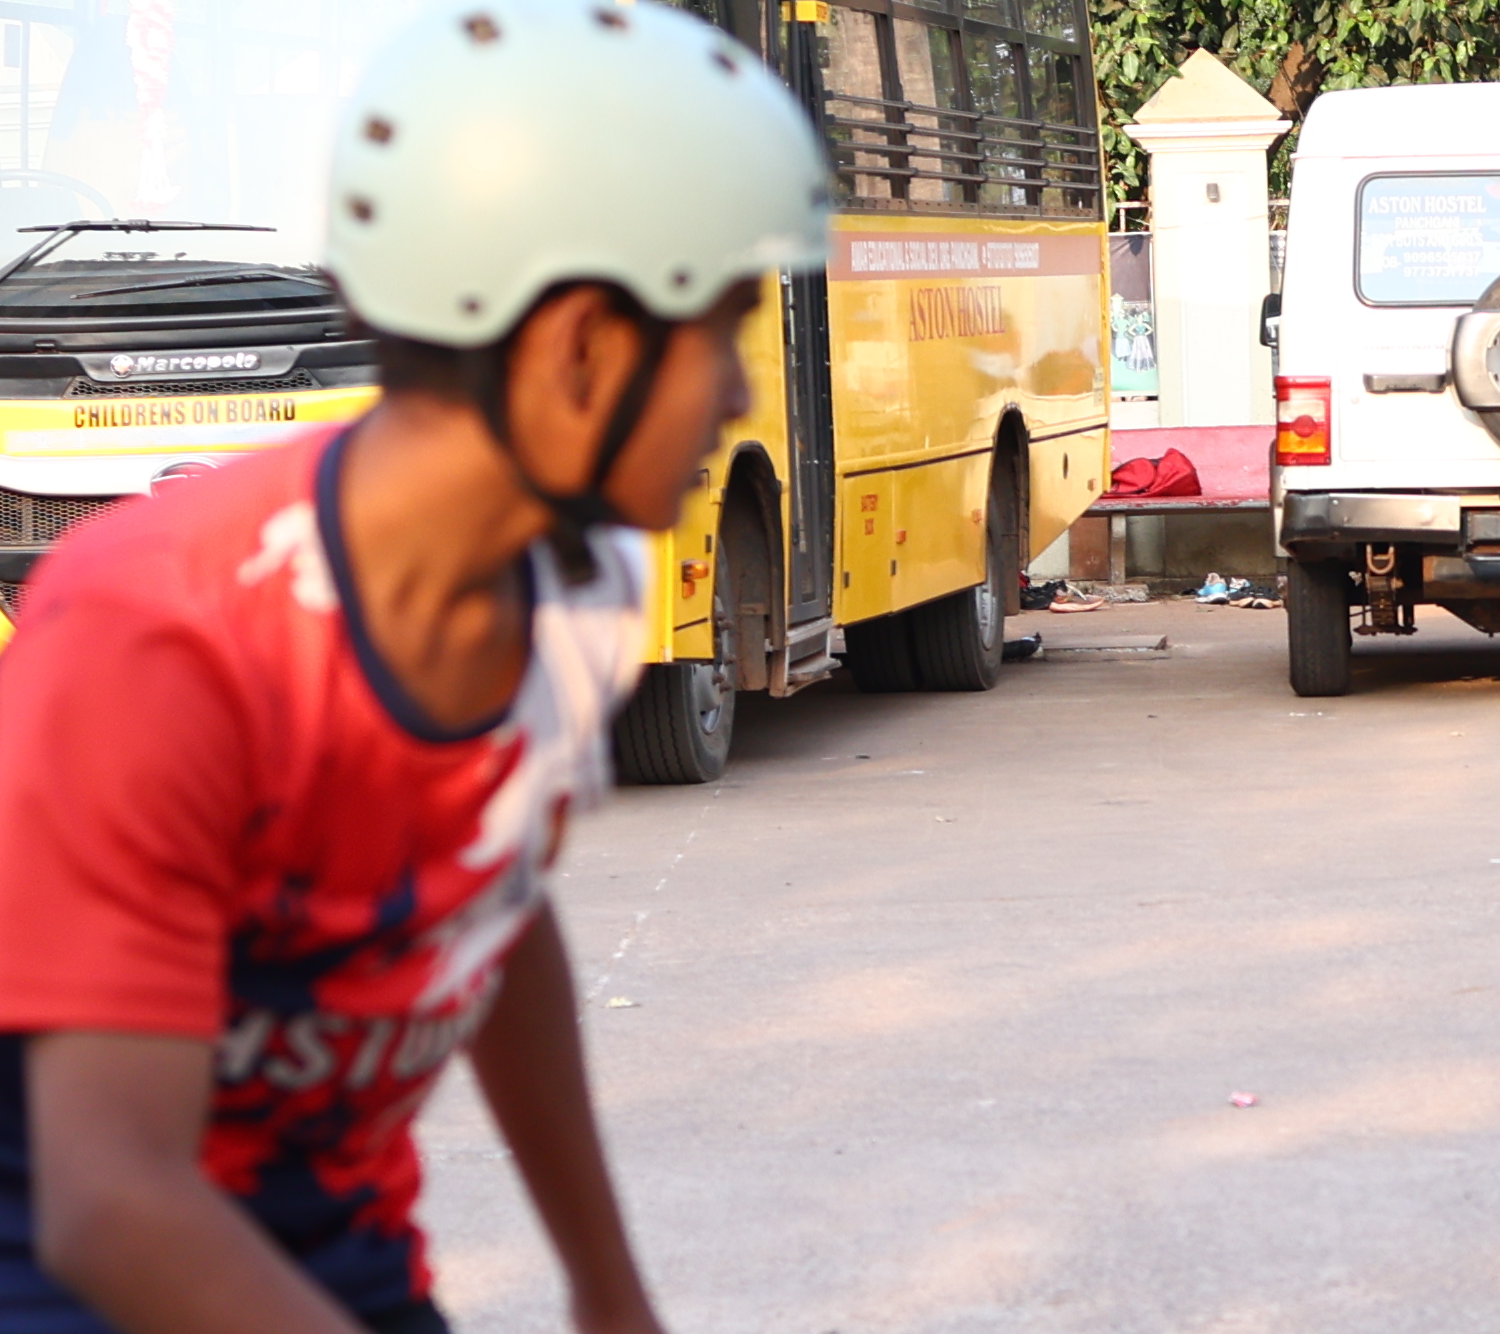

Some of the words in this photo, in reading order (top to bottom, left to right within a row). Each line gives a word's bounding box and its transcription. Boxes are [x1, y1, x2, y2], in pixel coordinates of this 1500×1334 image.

[1368, 196, 1421, 214] ASTON
[1424, 195, 1487, 214] HOSTEL
[1394, 216, 1460, 229] PANCHGANI
[909, 288, 955, 342] ASTON
[956, 285, 1006, 337] HOSTEL
[135, 353, 259, 372] Marcopolo
[74, 401, 186, 428] CHILDRENS
[192, 400, 219, 424] ON
[226, 397, 296, 423] BOARD
